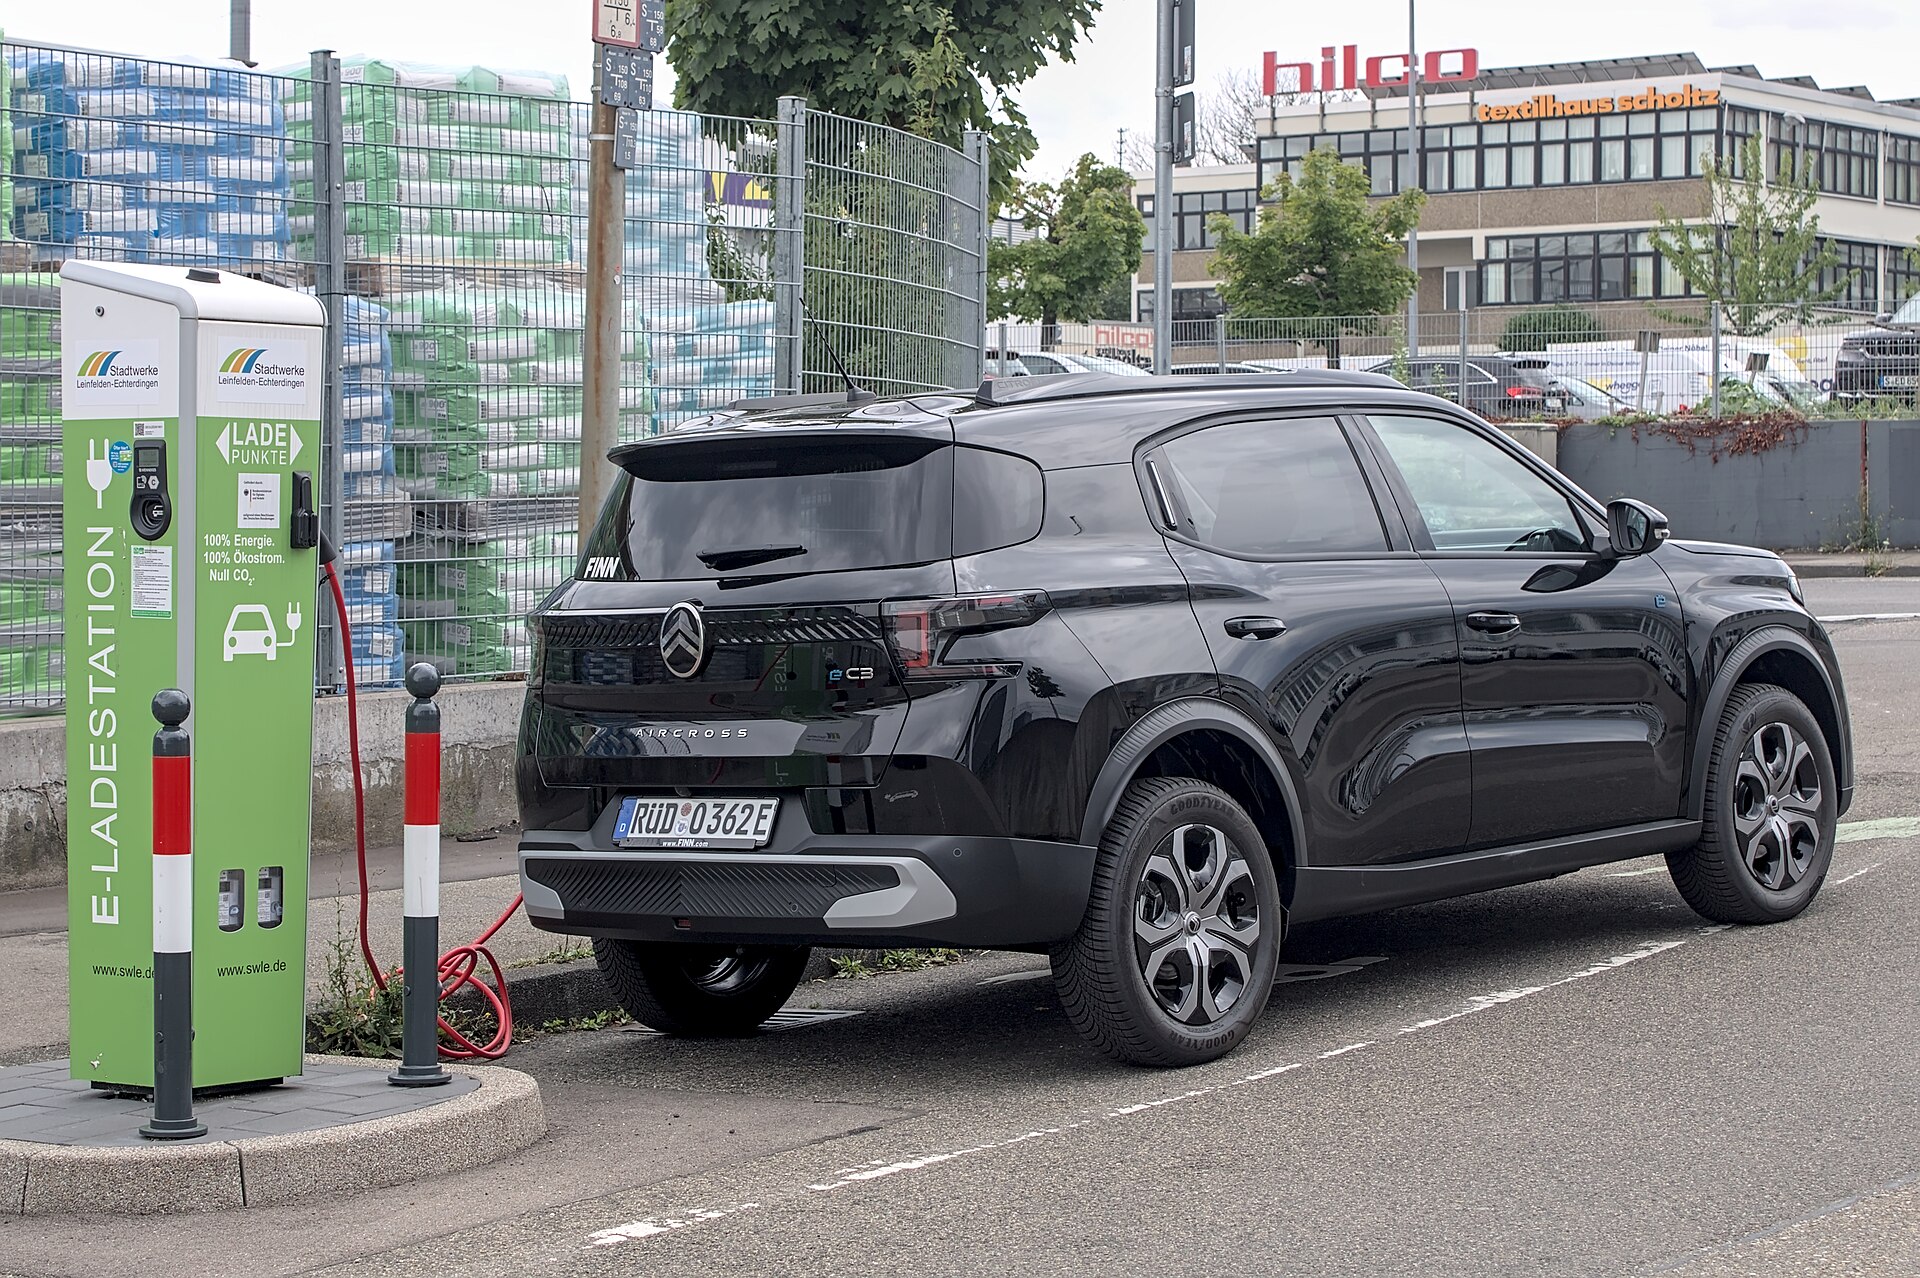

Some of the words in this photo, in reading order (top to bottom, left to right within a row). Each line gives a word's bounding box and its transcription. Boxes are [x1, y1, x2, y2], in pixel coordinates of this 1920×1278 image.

[653, 10, 664, 20] 150
[618, 64, 629, 75] 150
[642, 68, 653, 79] 150
[1263, 44, 1479, 96] hilco
[1477, 94, 1614, 122] textilhaus
[1617, 83, 1721, 112] scholtz
[109, 365, 159, 377] Stadtwerke
[254, 363, 305, 376] Stadtwerke
[76, 379, 159, 390] Leinfelden-Echterdingen
[218, 376, 305, 390] Leinfelden-Echterdingen
[232, 422, 287, 447] LADE
[231, 449, 287, 465] PUNKTE
[203, 533, 231, 547] 100%
[234, 533, 275, 549] Energie.
[203, 551, 231, 564] 100%
[233, 549, 286, 564] Ökostrom.
[583, 556, 621, 579] FINN
[209, 568, 230, 582] Null
[86, 526, 120, 926] E-LADESTATION
[634, 728, 748, 739] AIRCROSS
[1169, 796, 1237, 821] GOODYEAR
[619, 822, 627, 833] D
[662, 838, 709, 848] www.FINN.com
[217, 959, 287, 978] www.swle.de
[1169, 1029, 1236, 1051] GOODYEAR
